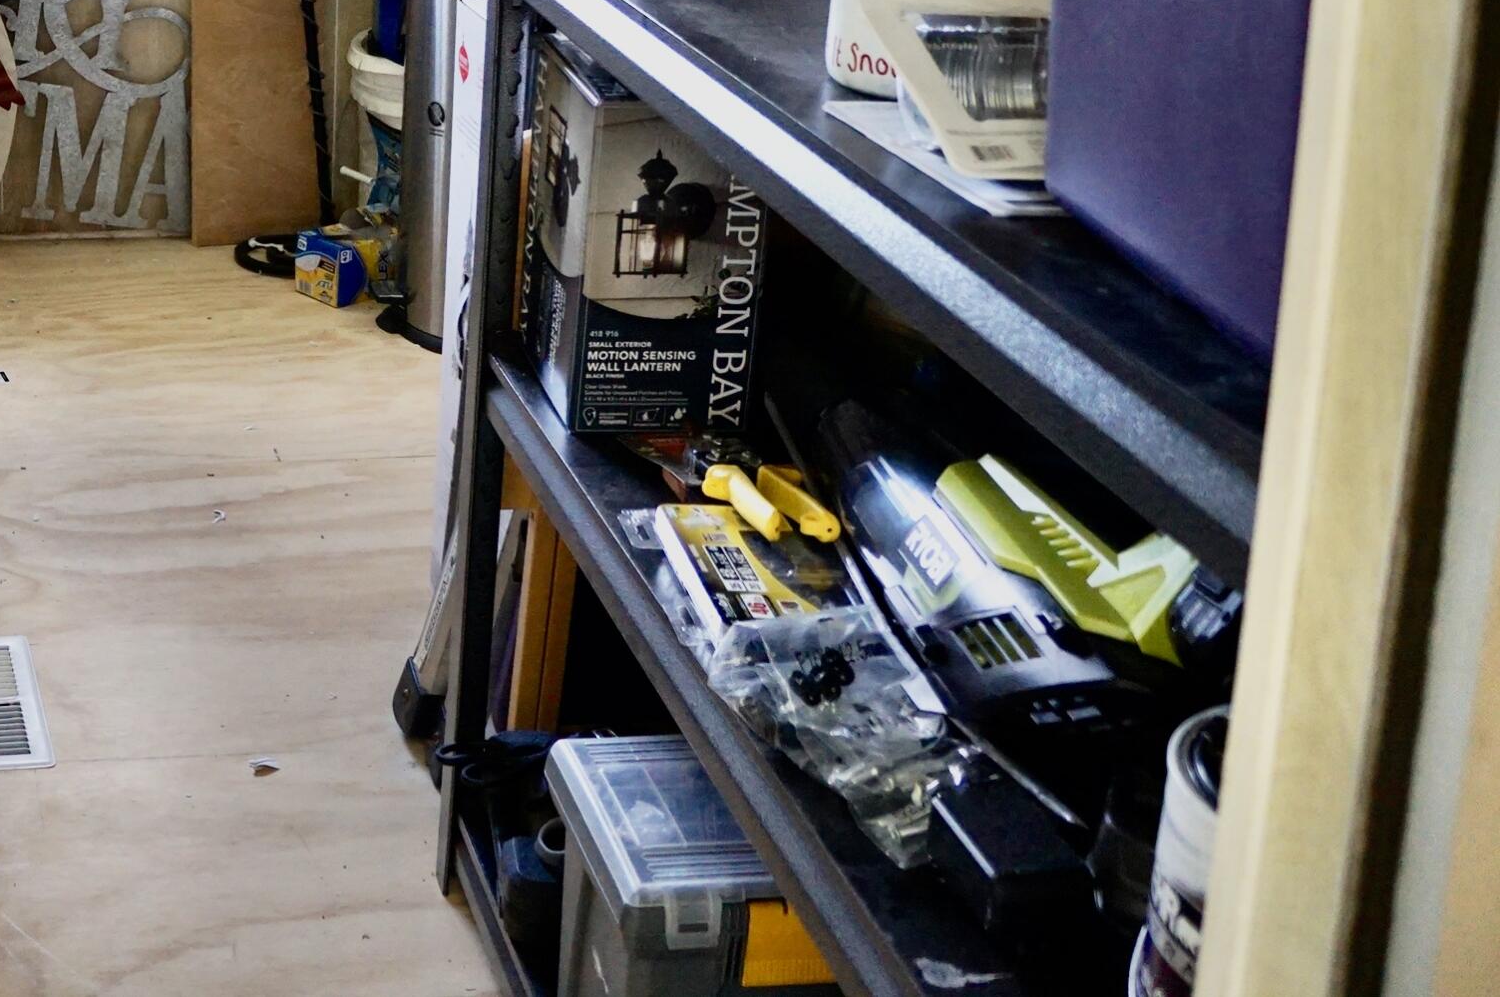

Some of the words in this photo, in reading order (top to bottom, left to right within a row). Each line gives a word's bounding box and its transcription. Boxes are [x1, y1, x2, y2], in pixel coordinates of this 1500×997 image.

[717, 174, 761, 338] MPTON
[587, 351, 639, 361] MOTION
[642, 350, 697, 361] SENSING
[587, 362, 620, 372] WALL
[623, 362, 682, 372] LANTERN
[708, 349, 747, 426] BAY
[904, 520, 955, 586] RYOBI
